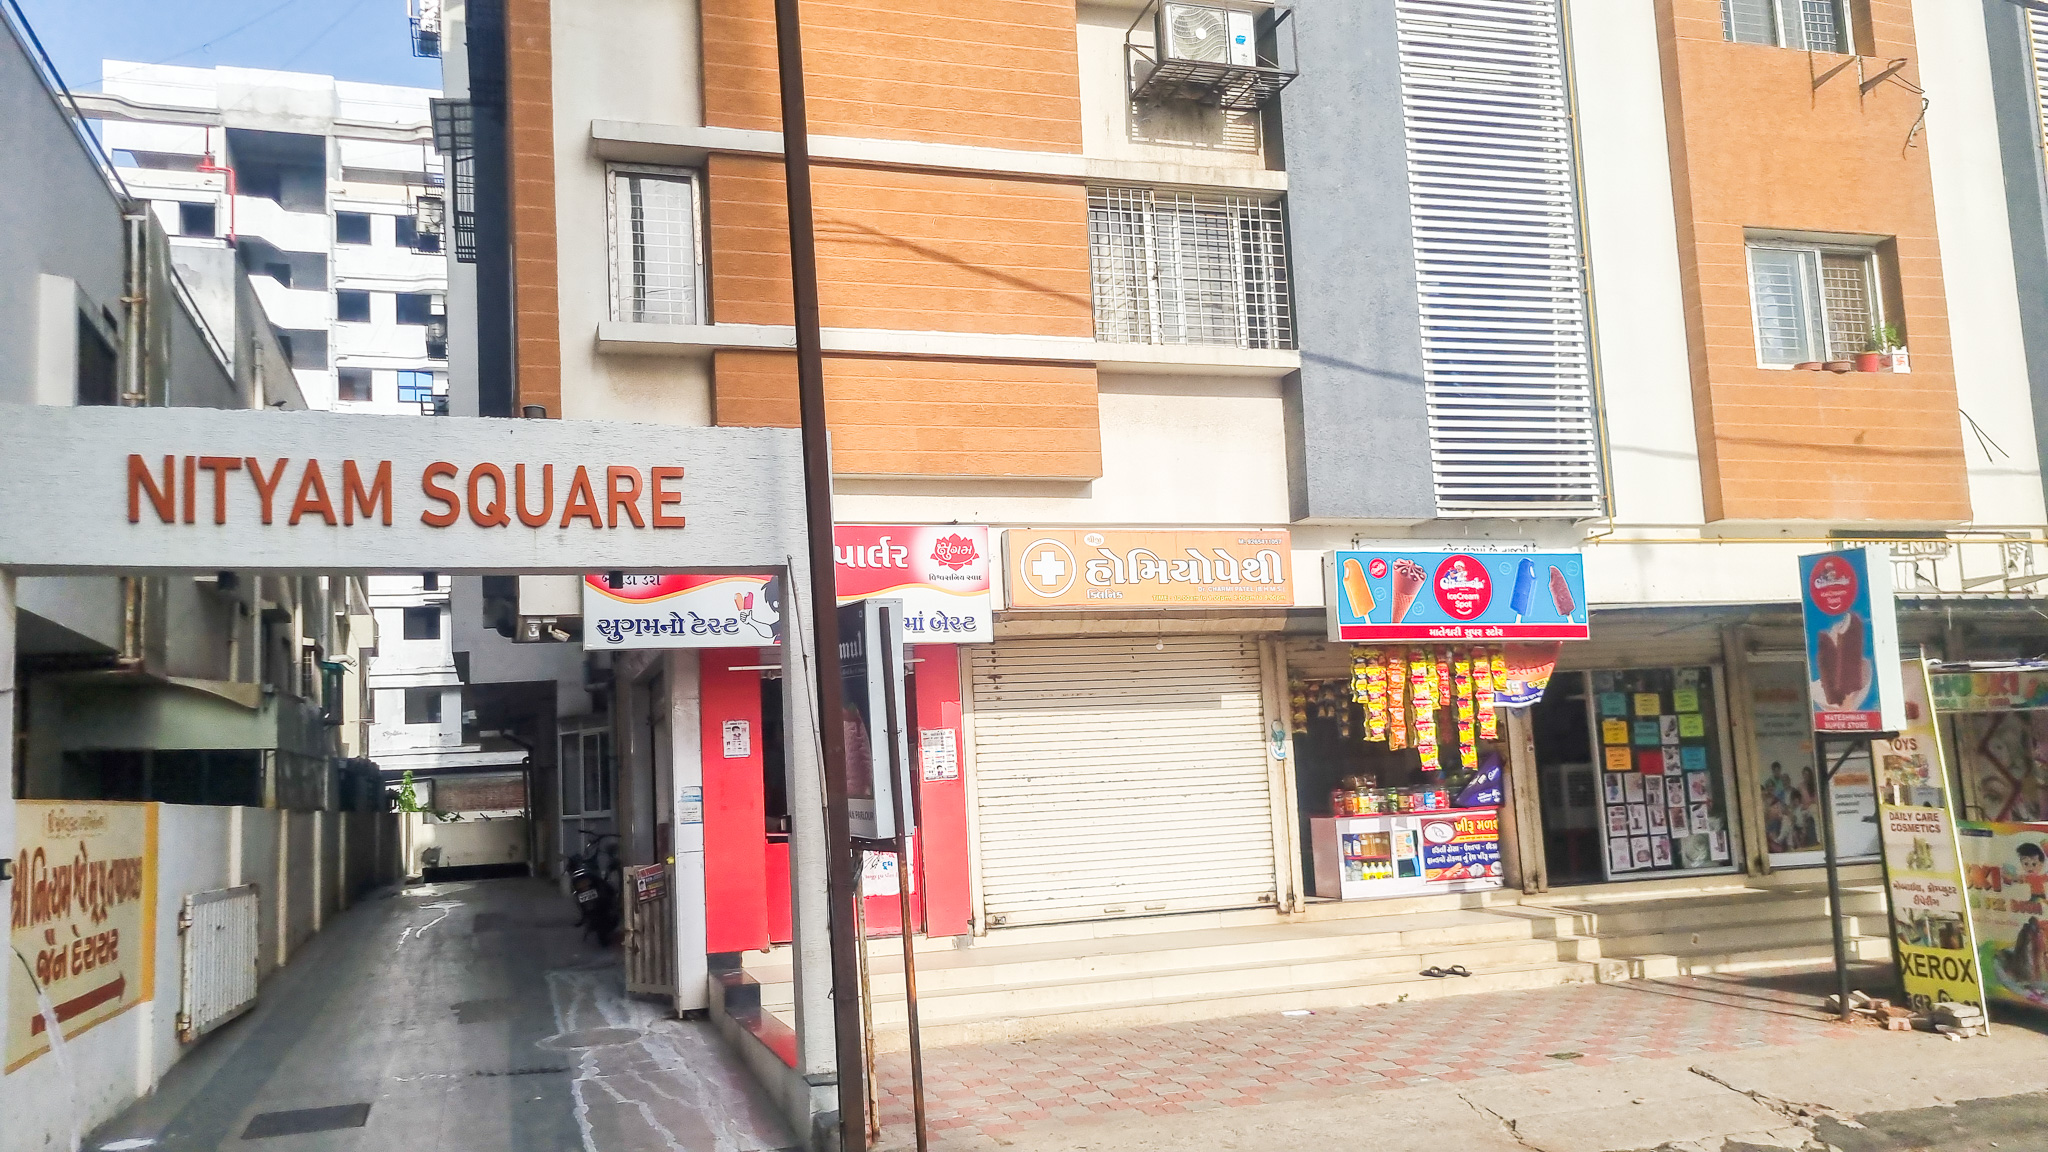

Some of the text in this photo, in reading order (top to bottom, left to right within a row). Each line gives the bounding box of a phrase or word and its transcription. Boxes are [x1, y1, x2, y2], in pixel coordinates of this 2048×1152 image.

[127, 453, 687, 530] NITYAM SQUARE
[1085, 548, 1286, 586] હોમિયોપેથી
[1455, 600, 1472, 609] Spot
[597, 611, 740, 643] સુગમનો ટેસ્ટ
[929, 610, 977, 632] બેસ્ટ
[1464, 628, 1483, 639] સુપર
[1485, 626, 1503, 637] સ્ટોર
[839, 630, 864, 661] mul
[1889, 738, 1918, 751] TOYS
[1889, 812, 1940, 822] DAILY CARE
[1891, 823, 1941, 833] COSMETICS
[1900, 952, 1976, 984] XEROX
